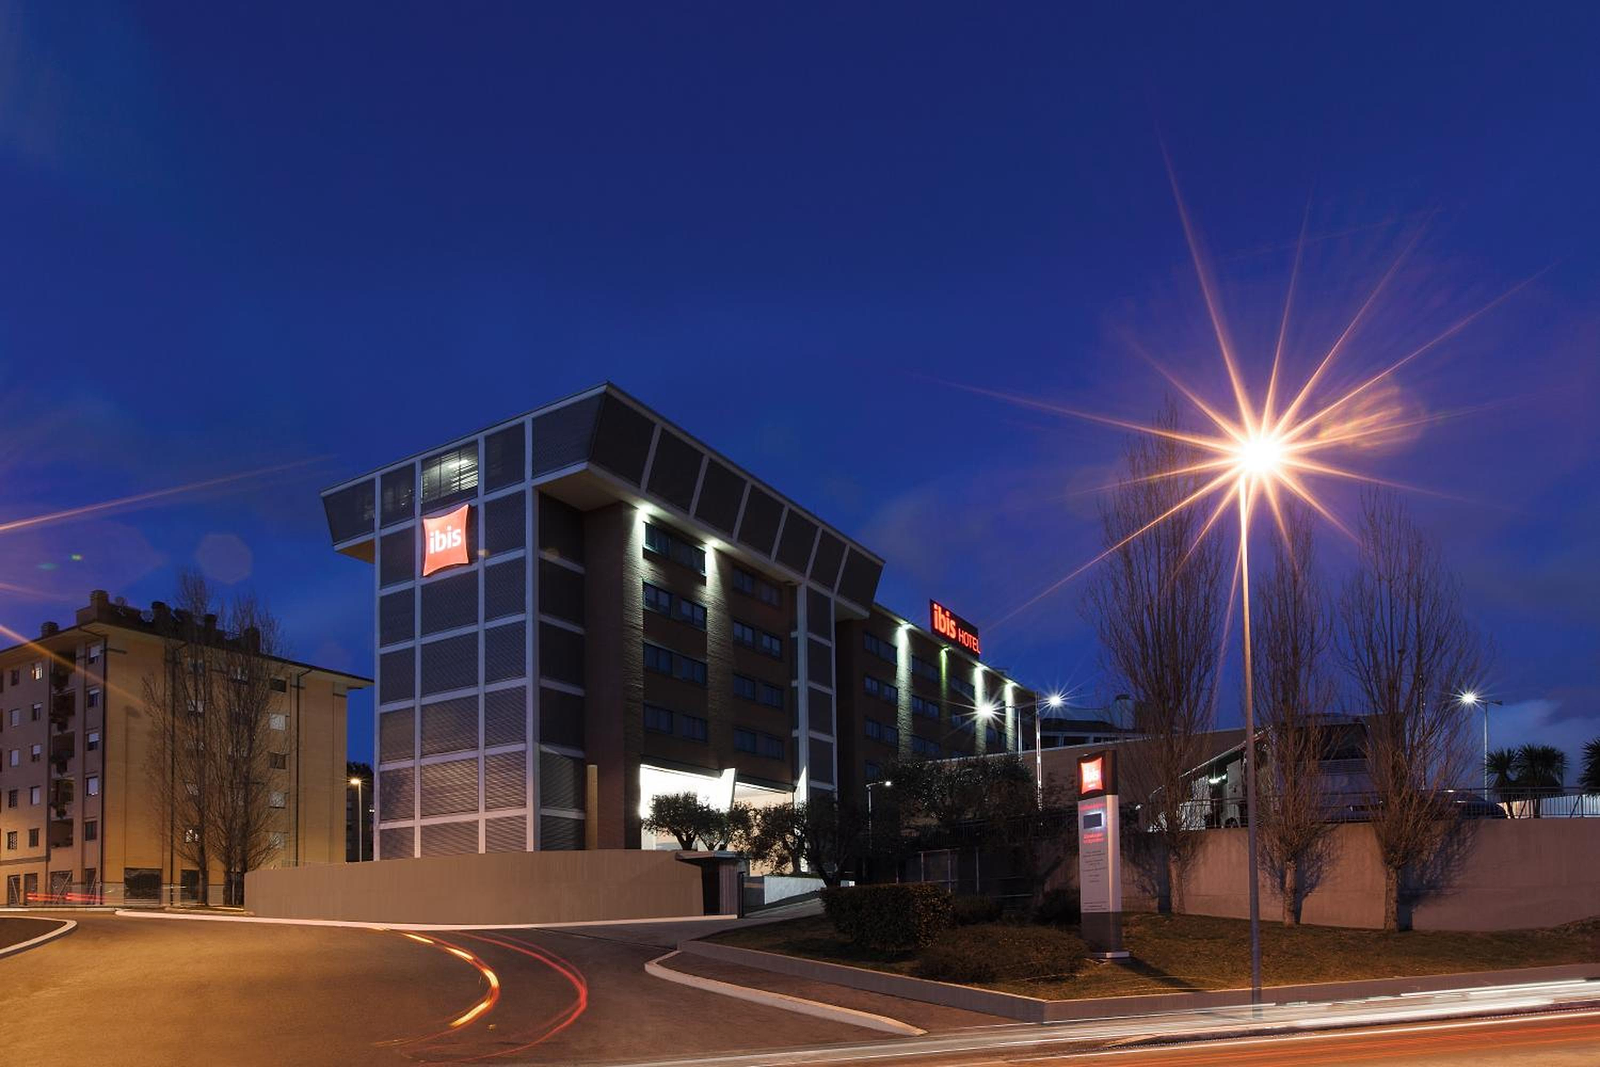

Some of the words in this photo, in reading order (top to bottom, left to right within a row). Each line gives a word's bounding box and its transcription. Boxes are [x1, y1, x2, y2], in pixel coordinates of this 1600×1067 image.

[429, 525, 462, 555] ibis
[933, 603, 957, 639] ibis
[958, 627, 981, 654] HOTEL
